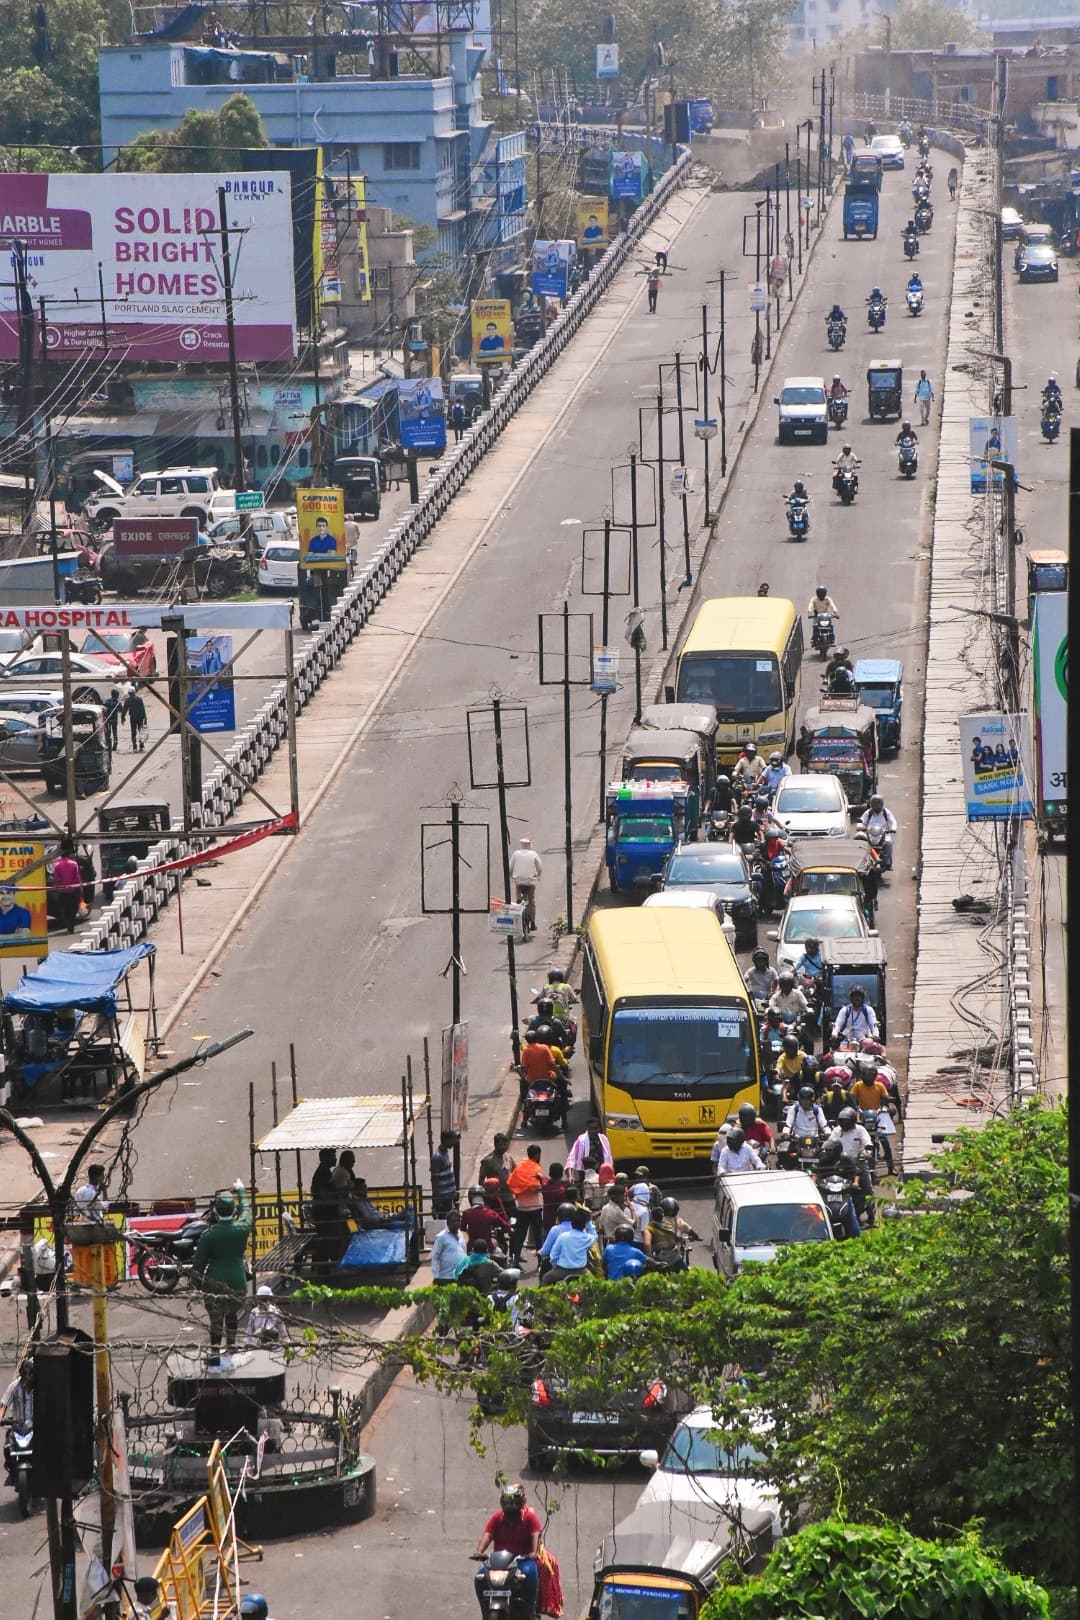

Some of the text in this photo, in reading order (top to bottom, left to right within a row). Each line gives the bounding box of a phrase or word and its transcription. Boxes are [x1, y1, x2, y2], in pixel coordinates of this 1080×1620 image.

[0, 214, 62, 233] ARBLE
[114, 207, 216, 234] SOLID
[115, 241, 216, 263] BRIGHT
[116, 272, 218, 296] HOMES
[114, 304, 221, 315] PORTLAND SLAG CEMENT
[121, 532, 152, 541] EXIDE
[0, 610, 131, 627] A HOSPITAL
[0, 847, 34, 856] TAIN
